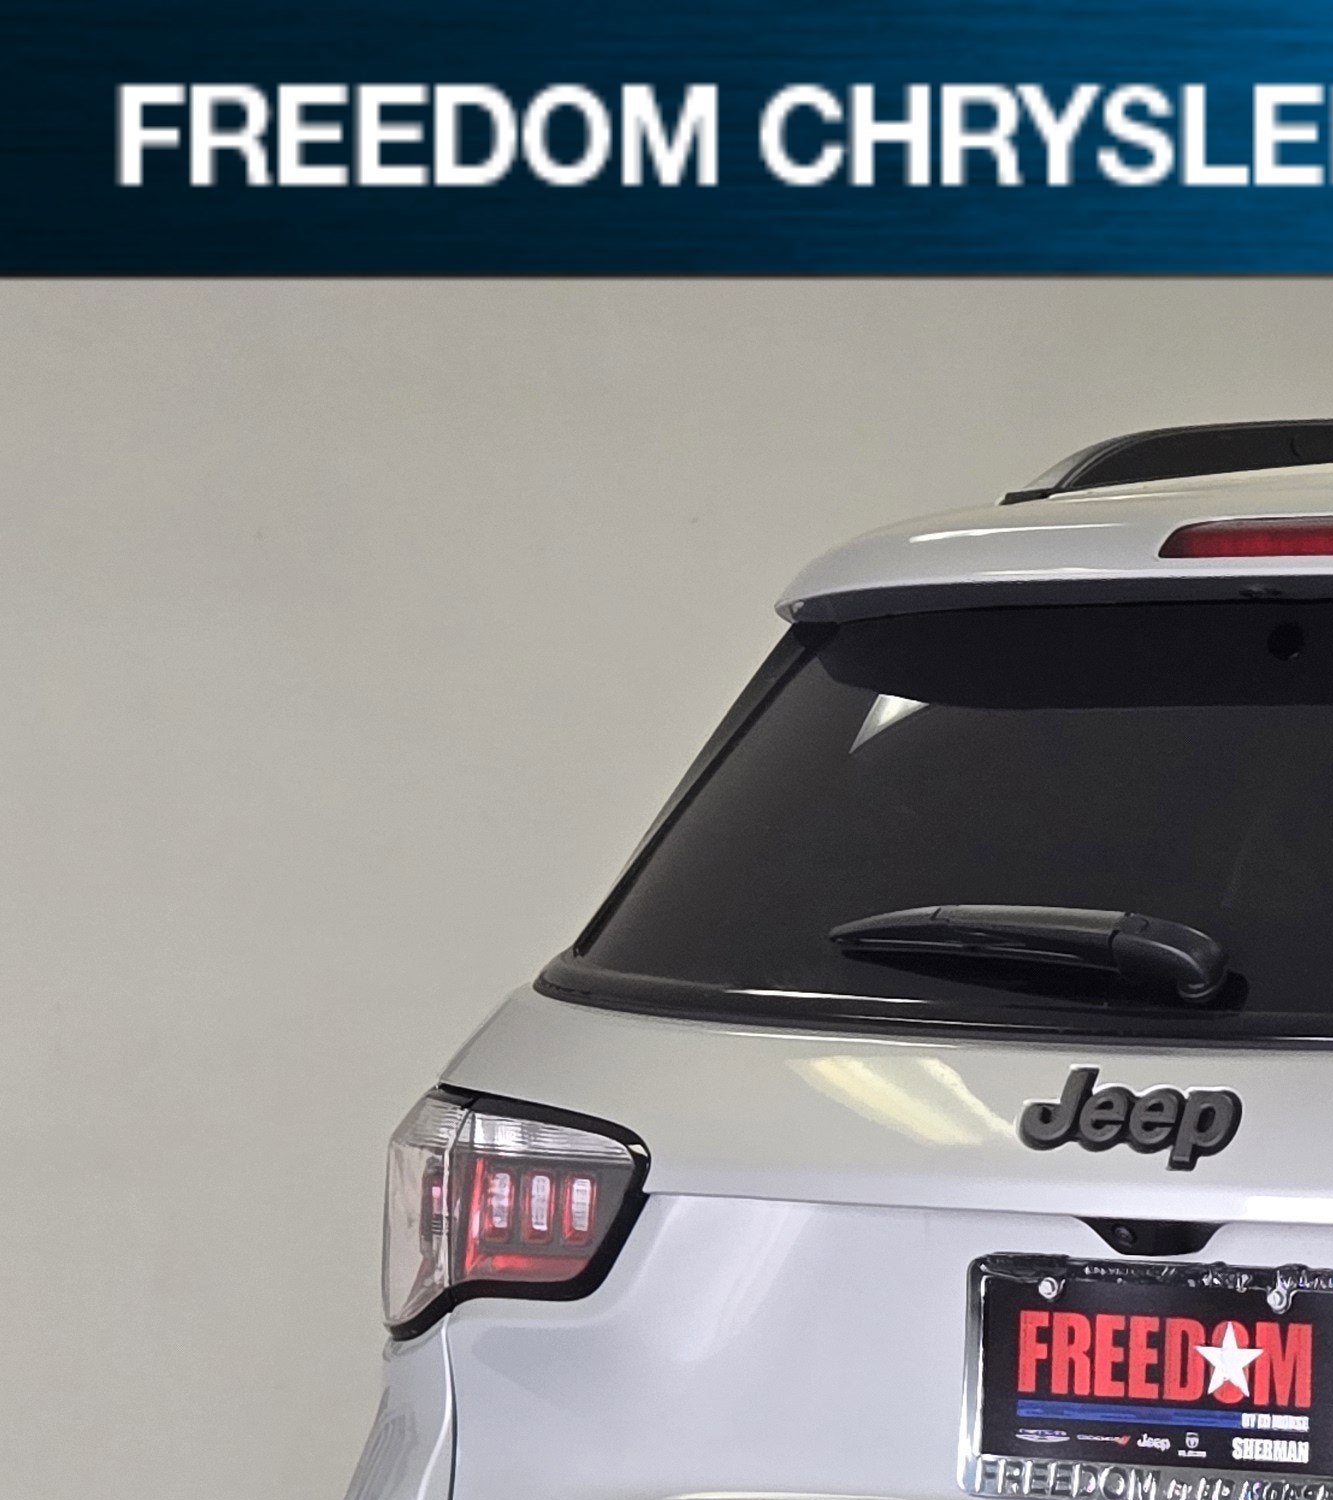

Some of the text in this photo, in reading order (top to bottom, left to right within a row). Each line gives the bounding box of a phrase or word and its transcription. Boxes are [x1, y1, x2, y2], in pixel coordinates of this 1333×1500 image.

[1018, 1064, 1244, 1172] Jeep
[1016, 1309, 1313, 1408] FREEDOM
[1137, 1433, 1171, 1452] Jeep
[1232, 1437, 1310, 1464] SHERMAN
